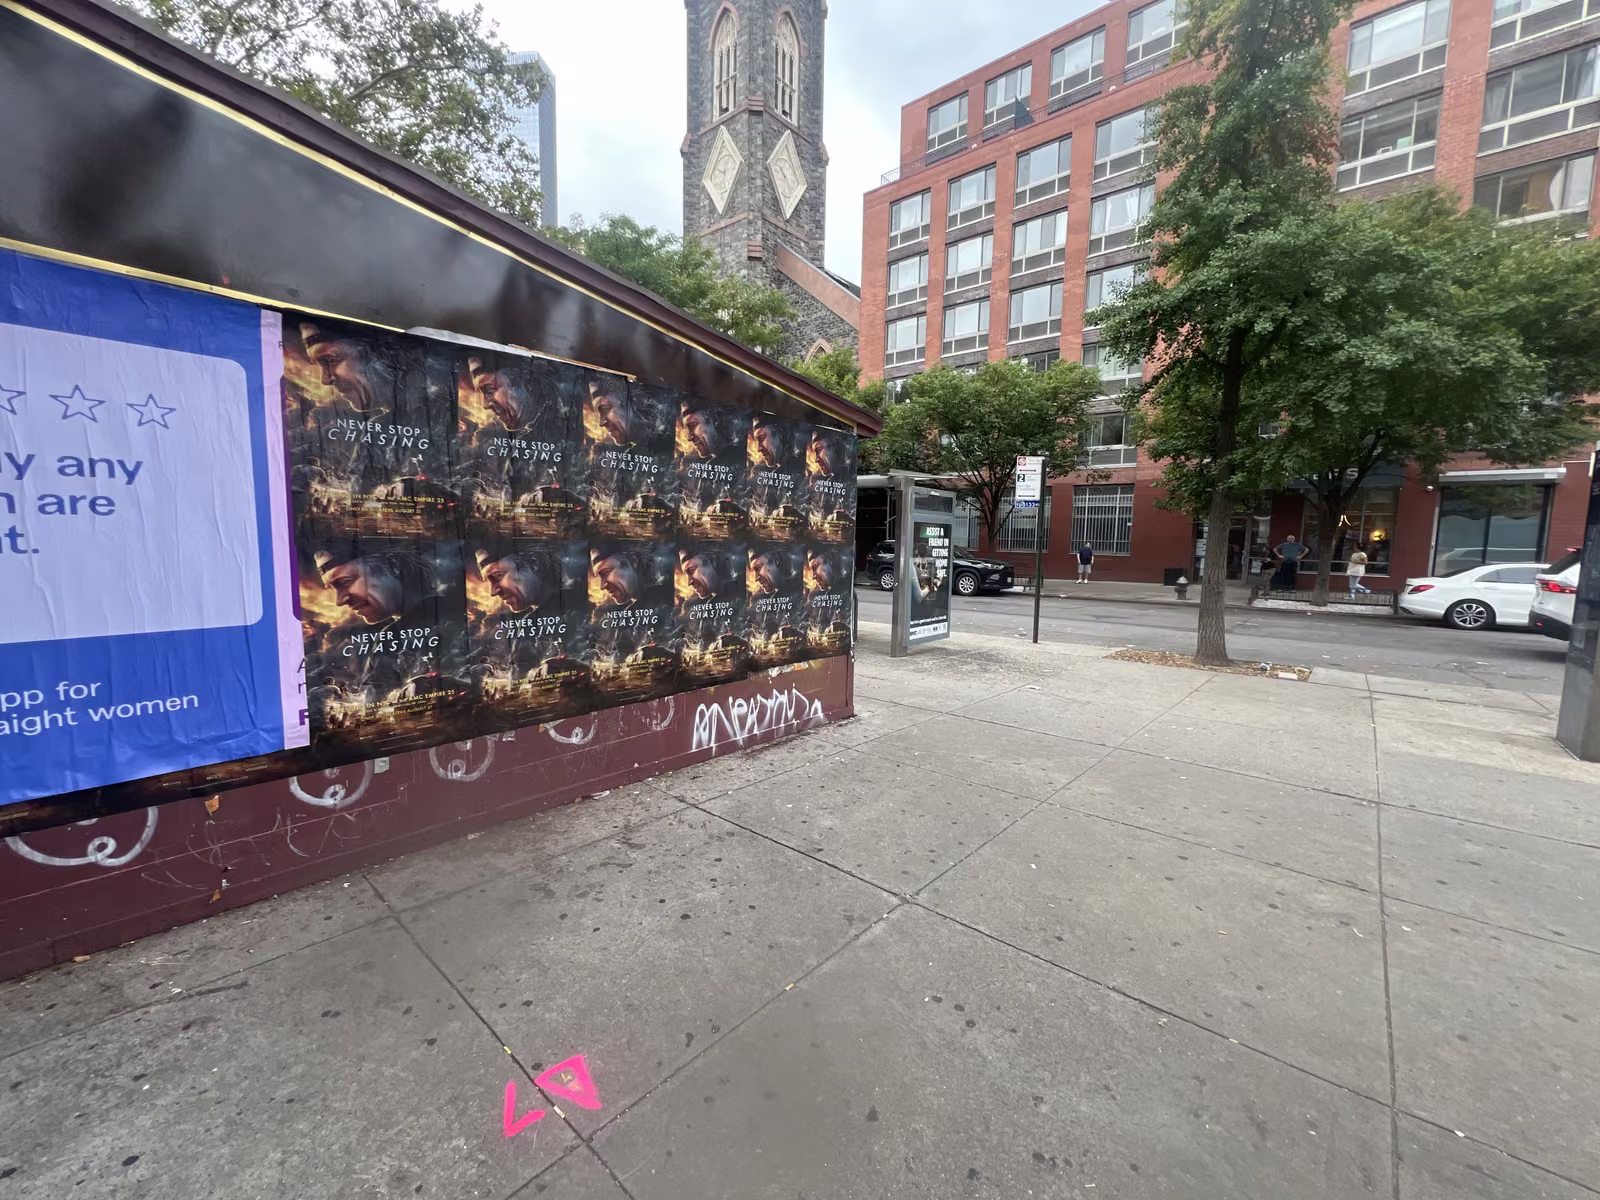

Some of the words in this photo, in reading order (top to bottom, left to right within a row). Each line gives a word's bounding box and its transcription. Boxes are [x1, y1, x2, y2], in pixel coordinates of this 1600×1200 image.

[337, 418, 382, 433] NEVER
[388, 424, 420, 436] STOP
[328, 428, 430, 450] CHASING
[494, 437, 527, 449] NEVER
[531, 441, 556, 451] STOP
[487, 446, 562, 462] CHASING
[606, 450, 631, 461] NEVER
[634, 454, 653, 464] STOP
[0, 452, 36, 480] y
[57, 456, 144, 485] any
[600, 458, 658, 473] CHASING
[692, 462, 712, 471] NEVER
[714, 464, 730, 473] STOP
[688, 469, 733, 481] CHASING
[37, 493, 116, 516] are
[0, 525, 39, 554] t.
[607, 610, 633, 619] NEVER
[635, 608, 653, 616] STOP
[689, 608, 733, 620] CHASING
[693, 603, 712, 611] NEVER
[500, 618, 533, 629] NEVER
[537, 616, 560, 626] STOP
[601, 616, 658, 629] CHASING
[351, 631, 394, 644] NEVER
[400, 627, 430, 639] STOP
[495, 624, 566, 640] CHASING
[342, 636, 439, 657] CHASING
[56, 681, 102, 701] for
[425, 690, 446, 698] EMPIRE
[88, 694, 199, 722] women
